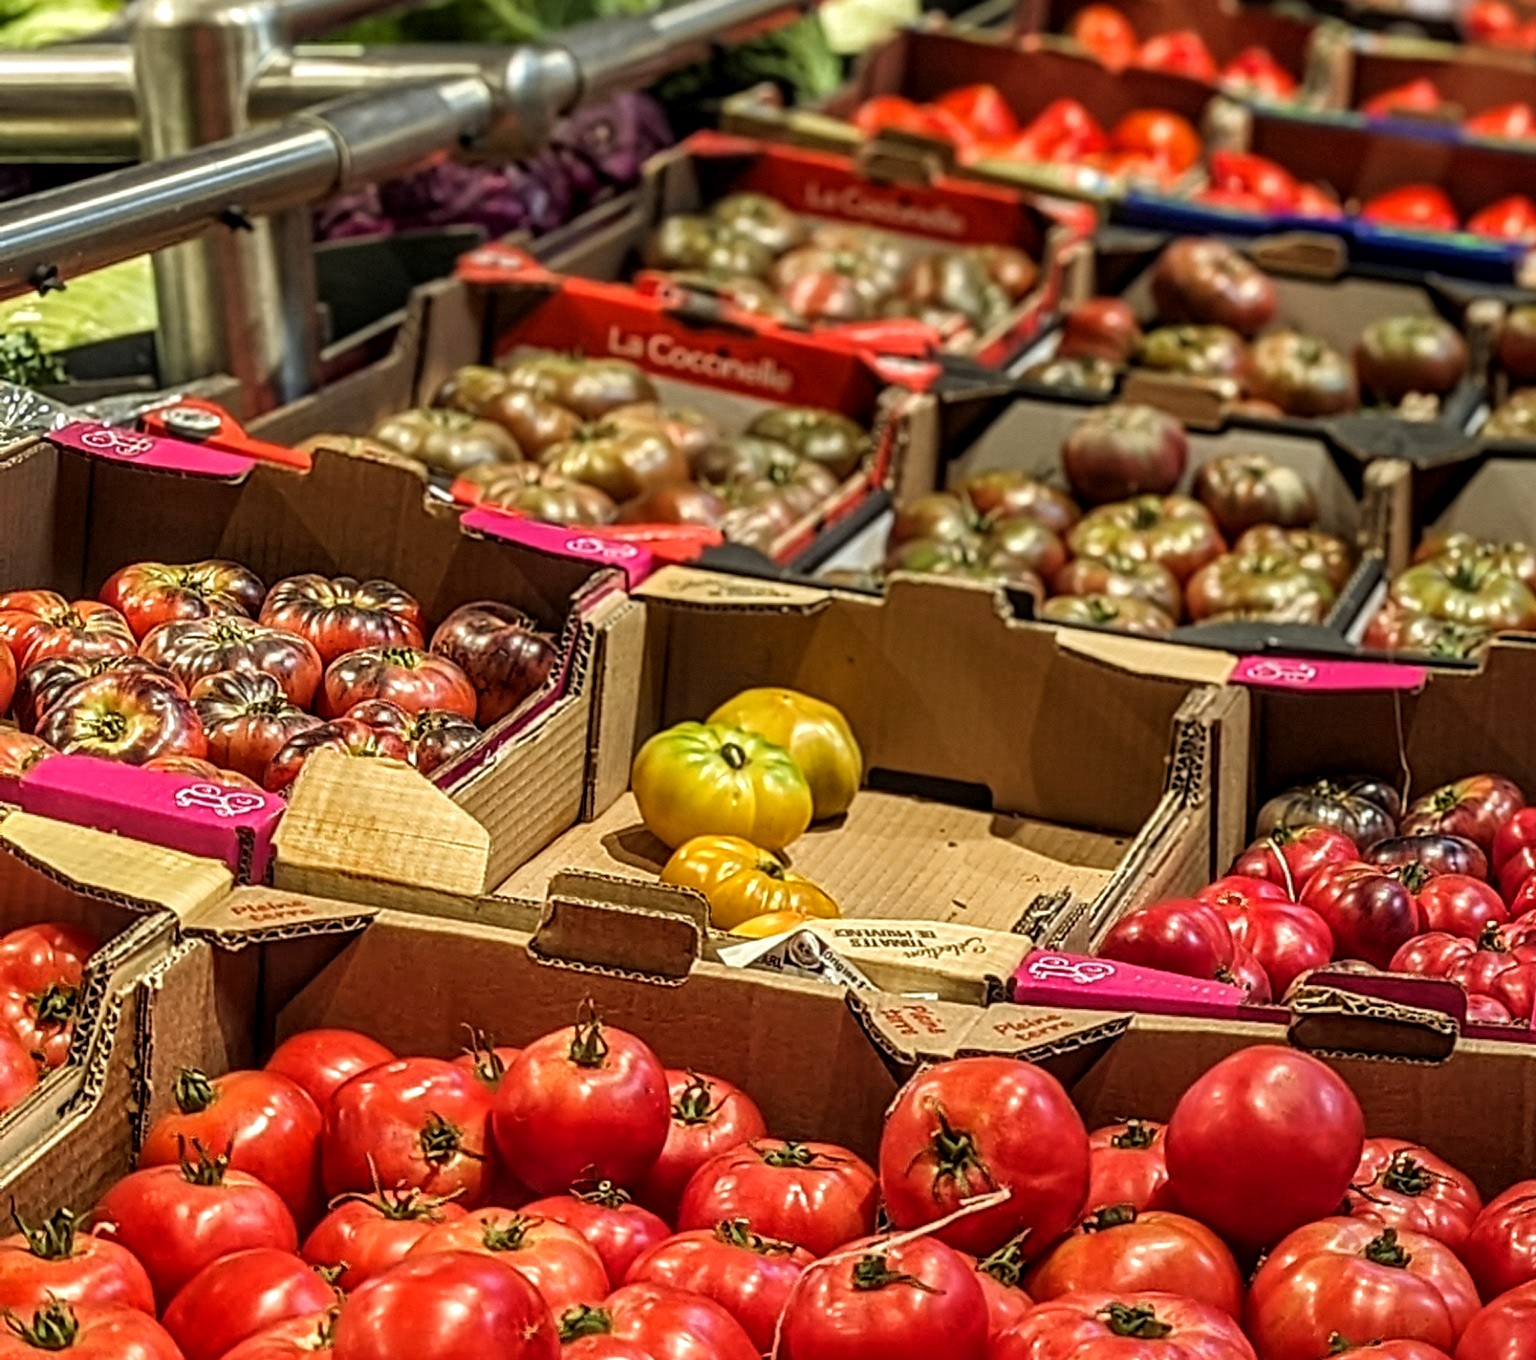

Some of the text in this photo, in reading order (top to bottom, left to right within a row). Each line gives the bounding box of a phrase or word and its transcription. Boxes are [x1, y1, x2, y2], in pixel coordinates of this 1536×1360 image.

[608, 326, 644, 358] La
[823, 951, 858, 983] Origine
[993, 1015, 1061, 1035] Pleine
